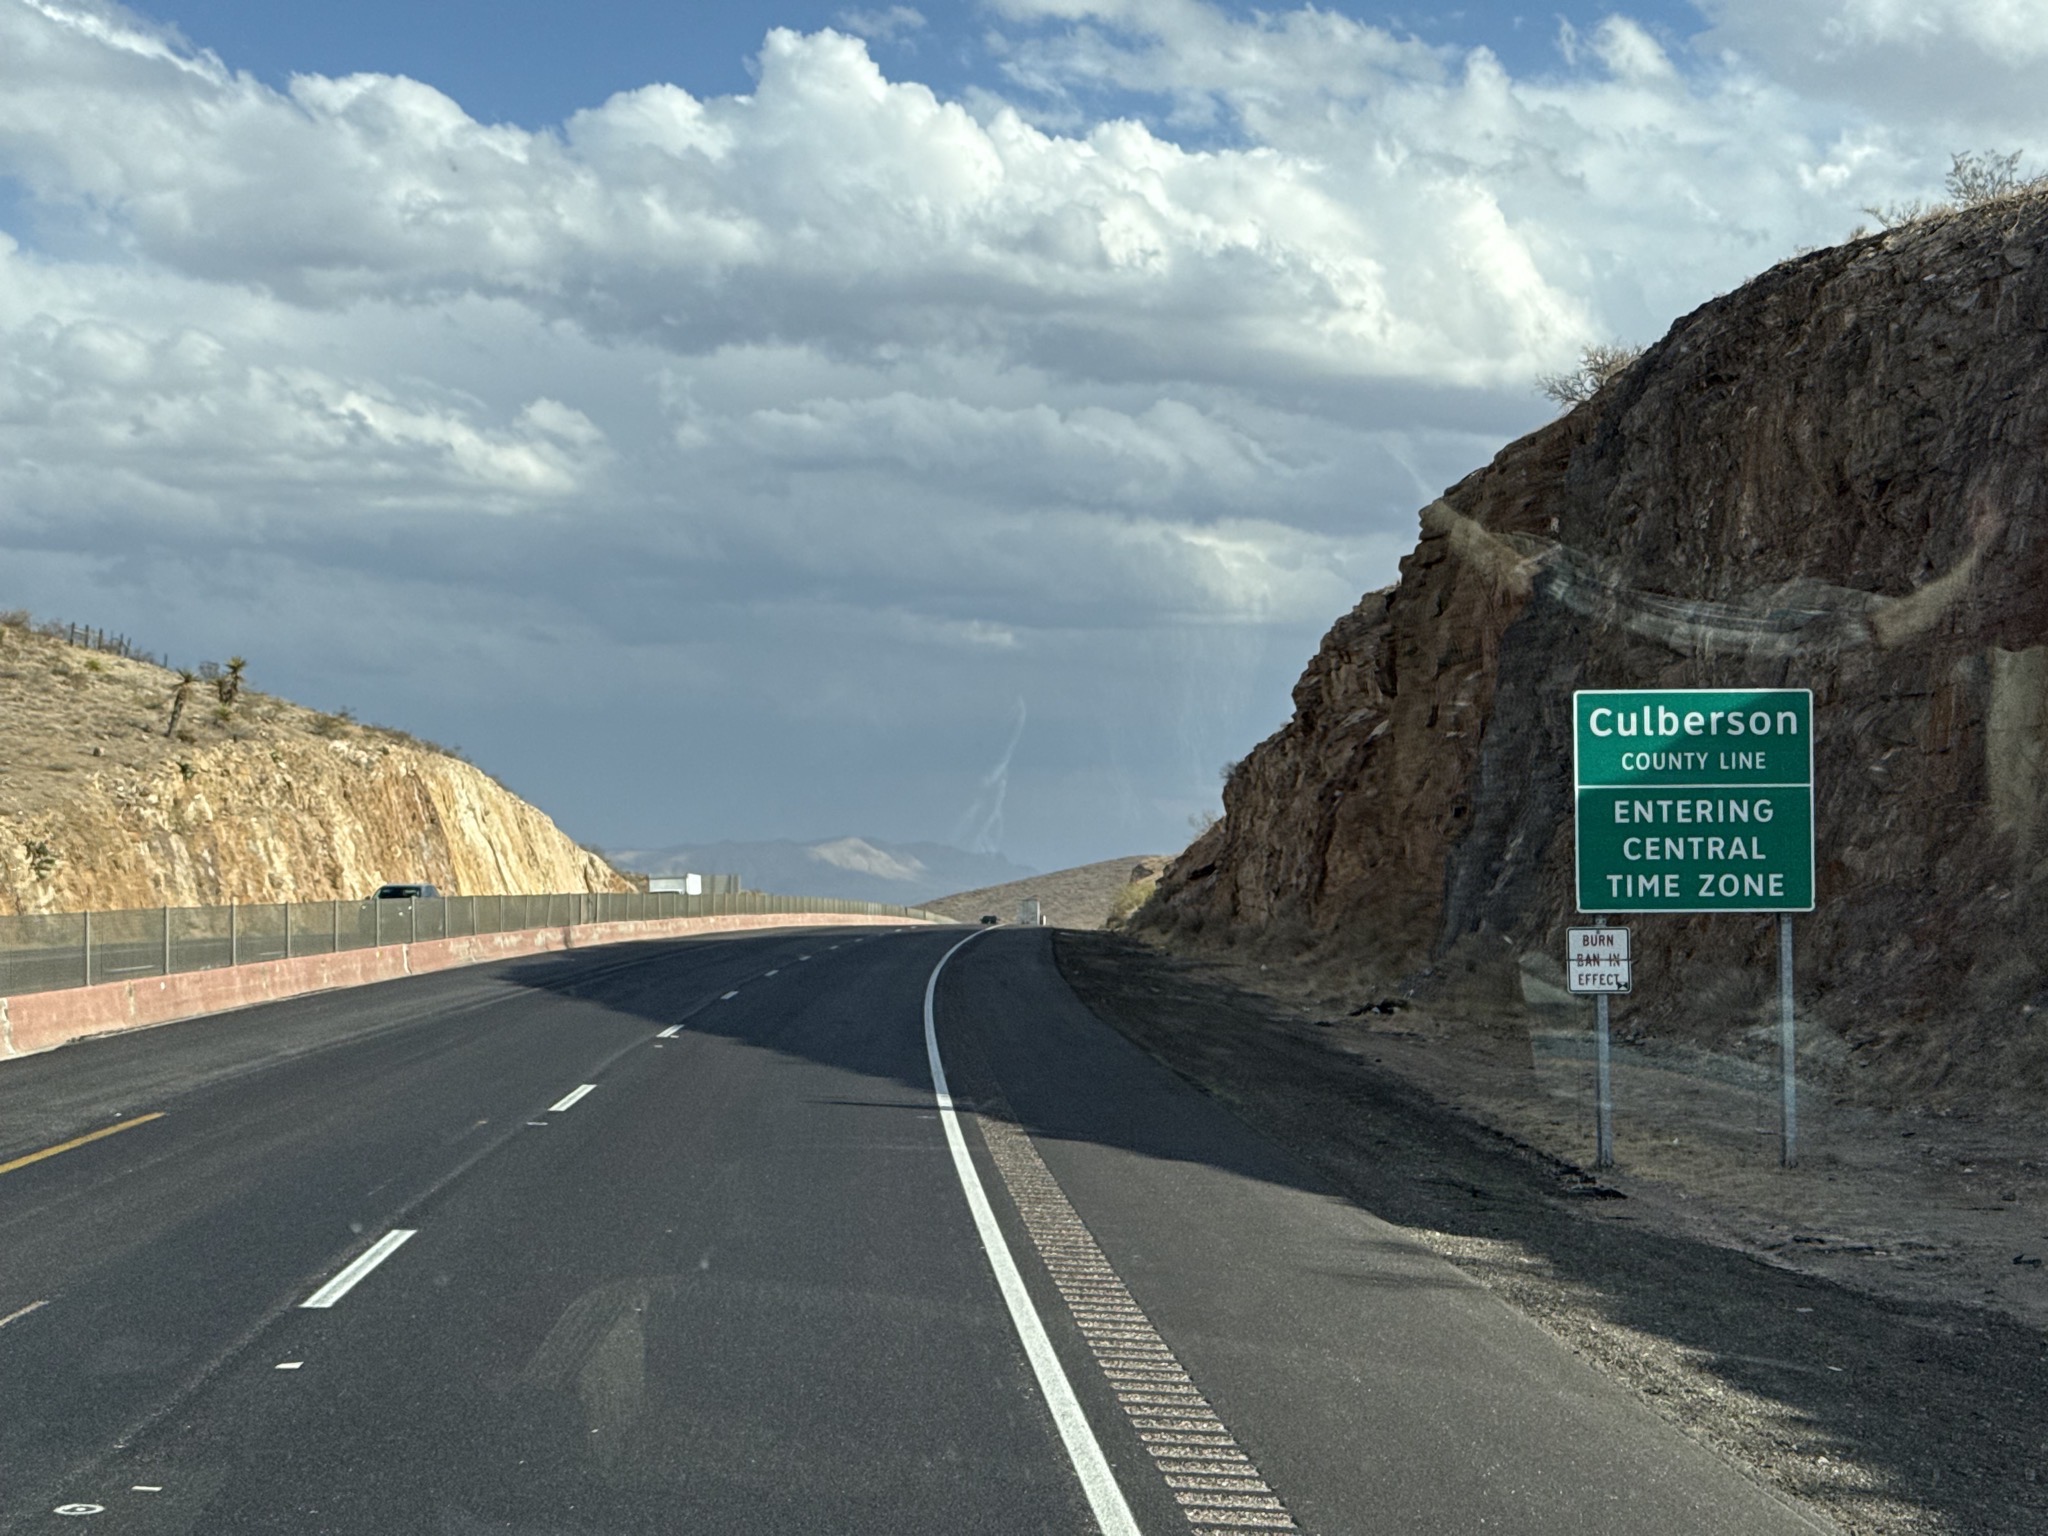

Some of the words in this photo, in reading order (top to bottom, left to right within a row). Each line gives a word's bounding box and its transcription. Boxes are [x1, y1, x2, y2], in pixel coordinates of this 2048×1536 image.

[1589, 705, 1798, 737] Culberson
[1621, 752, 1708, 771] COUNTY
[1719, 751, 1767, 770] LINE
[1614, 799, 1774, 824] ENTERING
[1623, 836, 1767, 861] CENTRAL
[1606, 874, 1680, 898] TIME
[1698, 873, 1784, 897] ZONE
[1582, 934, 1614, 947] BURN
[1576, 953, 1600, 967] BAN
[1608, 953, 1621, 967] IN
[1578, 973, 1620, 986] EFFECT
